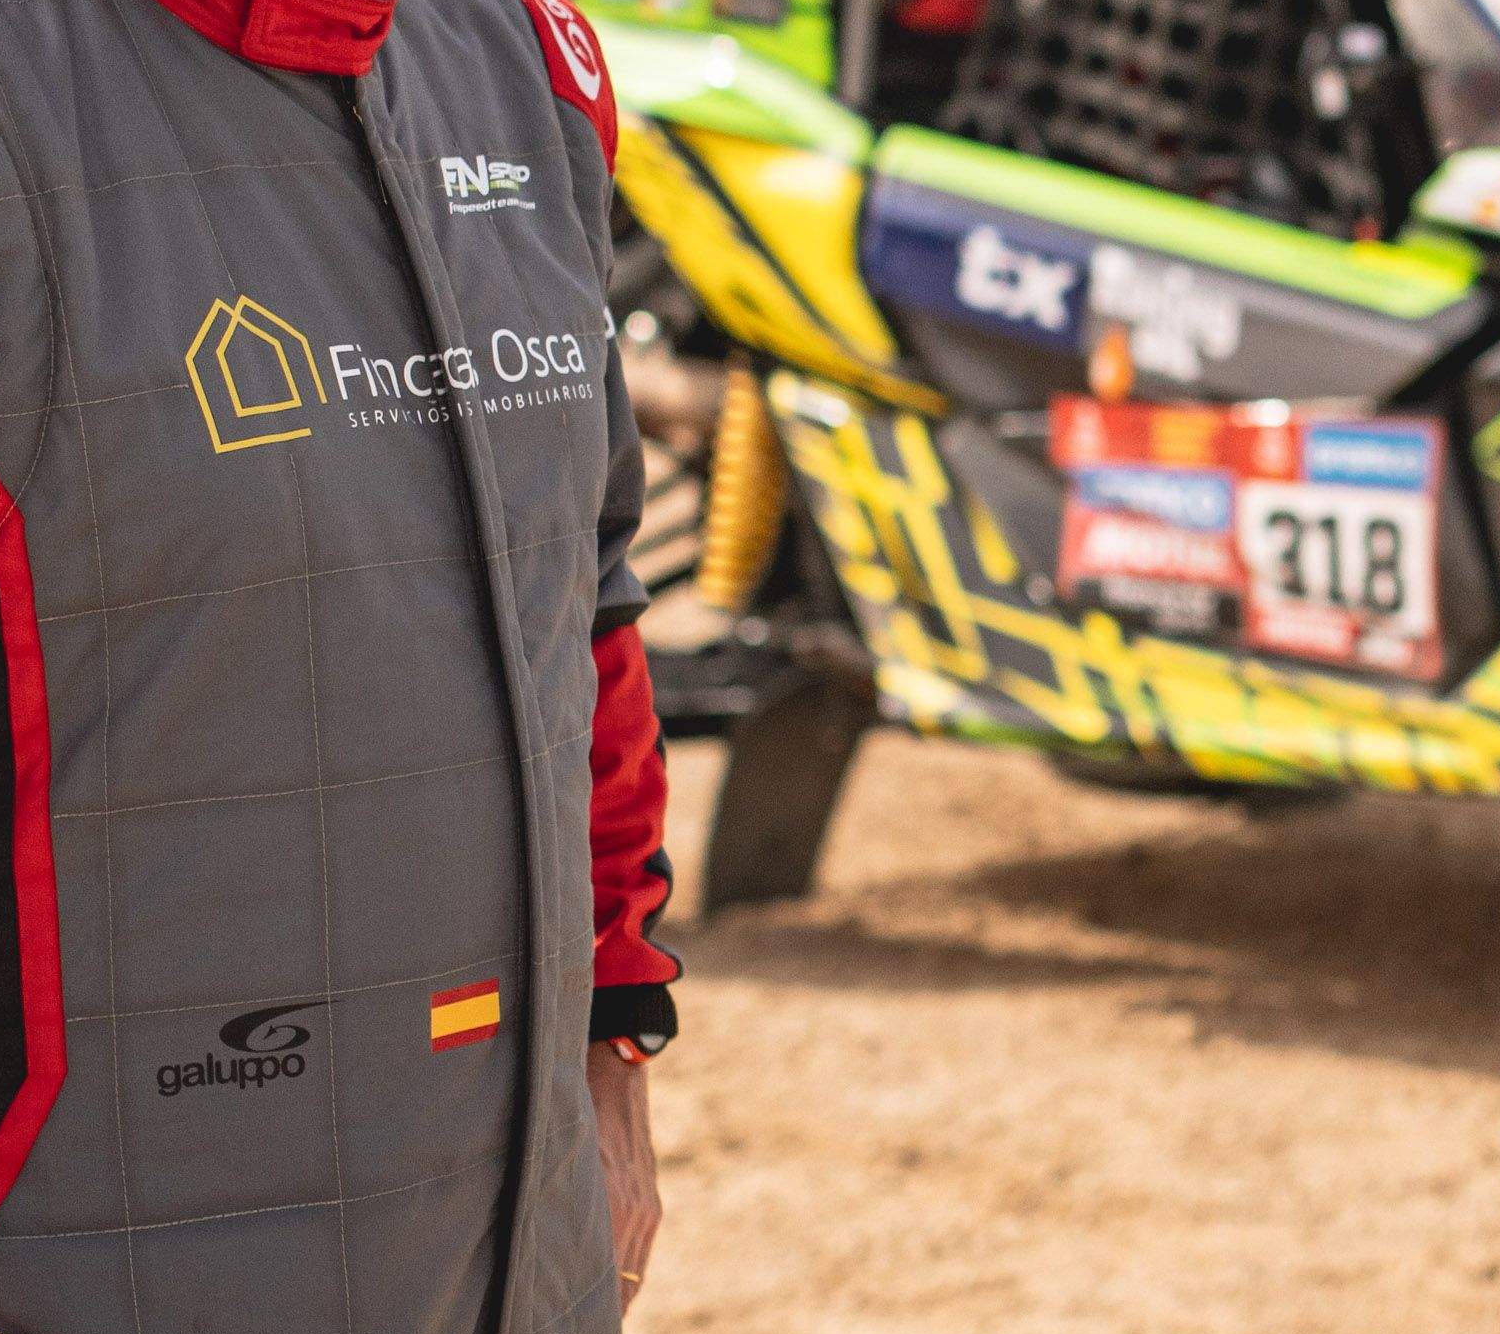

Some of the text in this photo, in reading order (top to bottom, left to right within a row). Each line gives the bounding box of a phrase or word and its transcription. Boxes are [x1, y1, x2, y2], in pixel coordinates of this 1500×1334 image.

[491, 328, 586, 383] Osca
[1264, 508, 1405, 614] 318
[156, 1052, 306, 1096] galuppo
